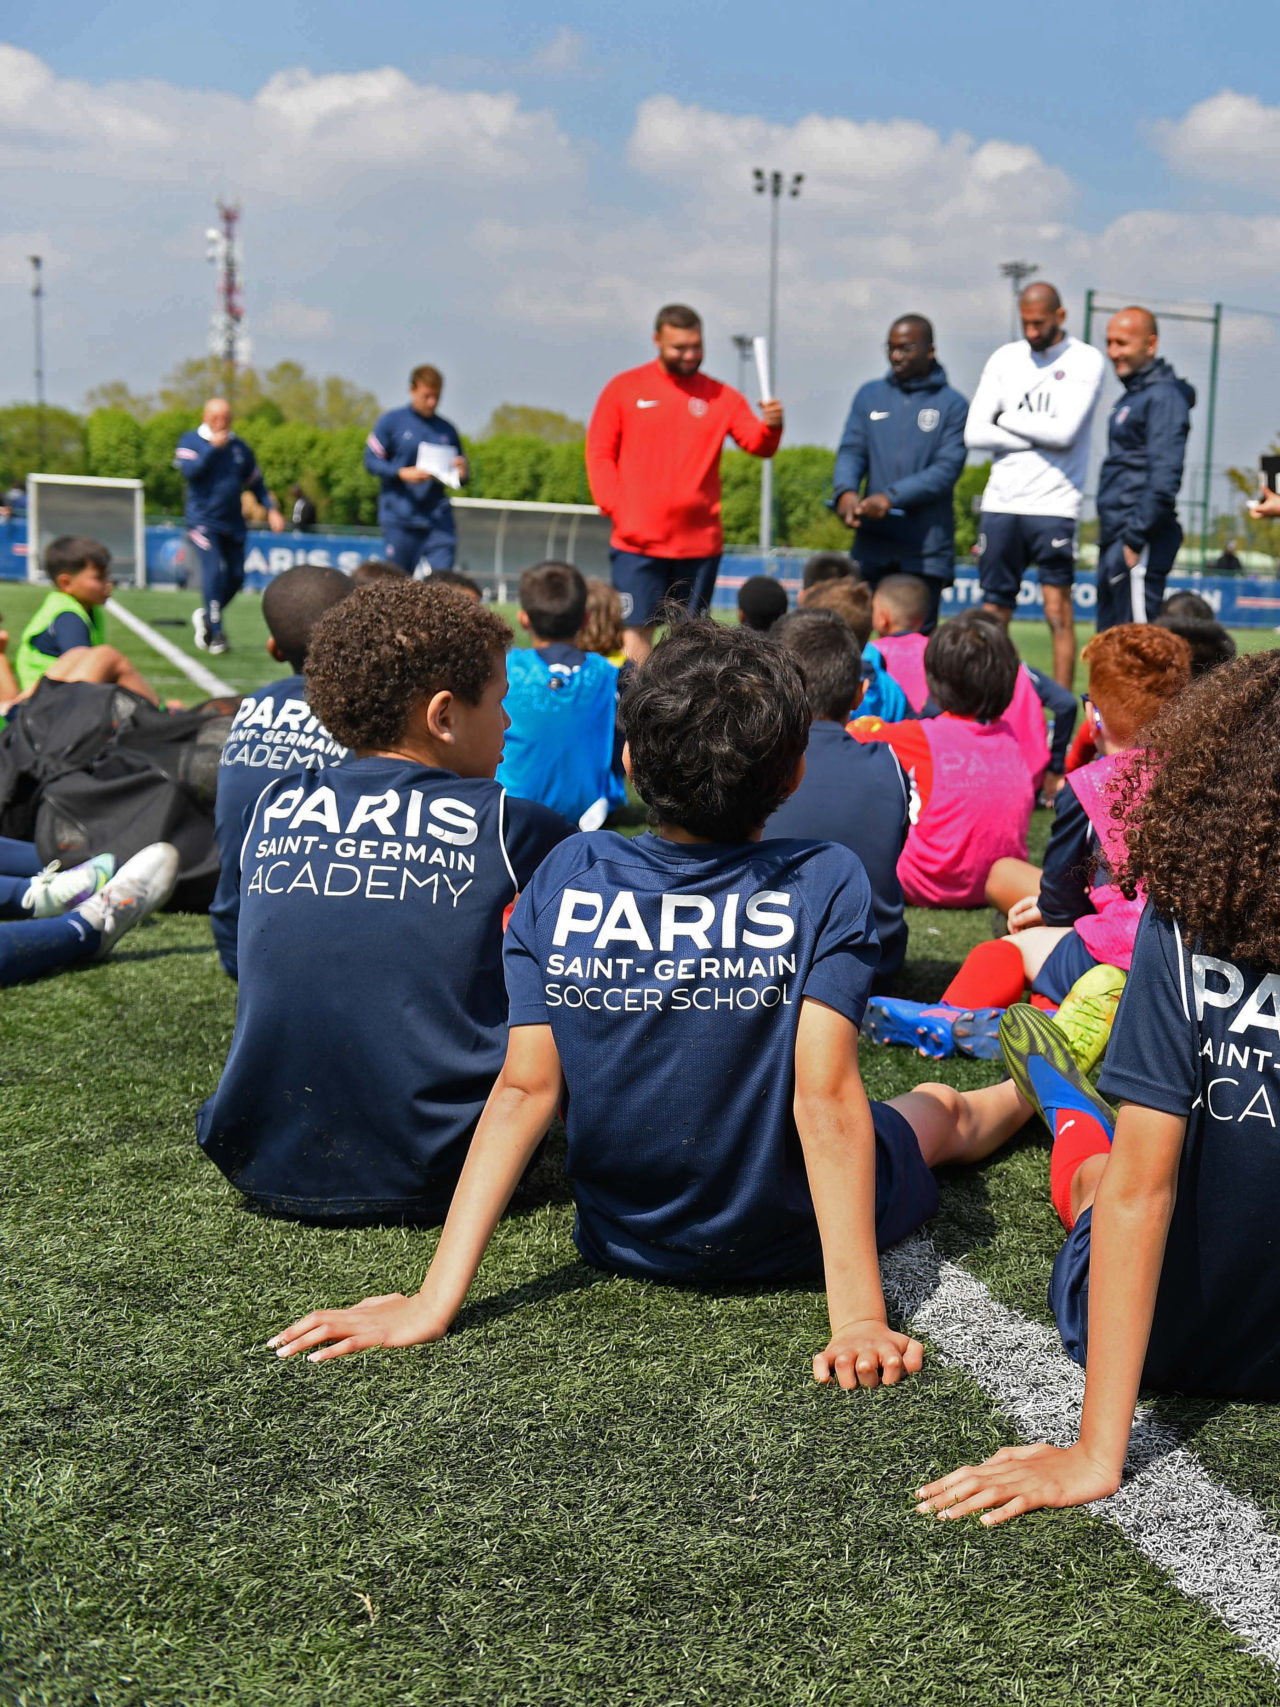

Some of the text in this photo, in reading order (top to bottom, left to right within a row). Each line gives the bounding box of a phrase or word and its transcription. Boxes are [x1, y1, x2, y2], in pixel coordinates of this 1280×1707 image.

[243, 547, 332, 577] ARIS
[226, 728, 349, 759] AINT-GERMAIN
[264, 786, 479, 847] PARIS
[255, 836, 475, 873] SAINT-GERMAIN
[248, 861, 473, 908] ACADEMY
[552, 888, 795, 952] PARIS
[546, 953, 797, 981] SAINT-GERMAIN
[545, 983, 792, 1011] SOCCER SCHOOL
